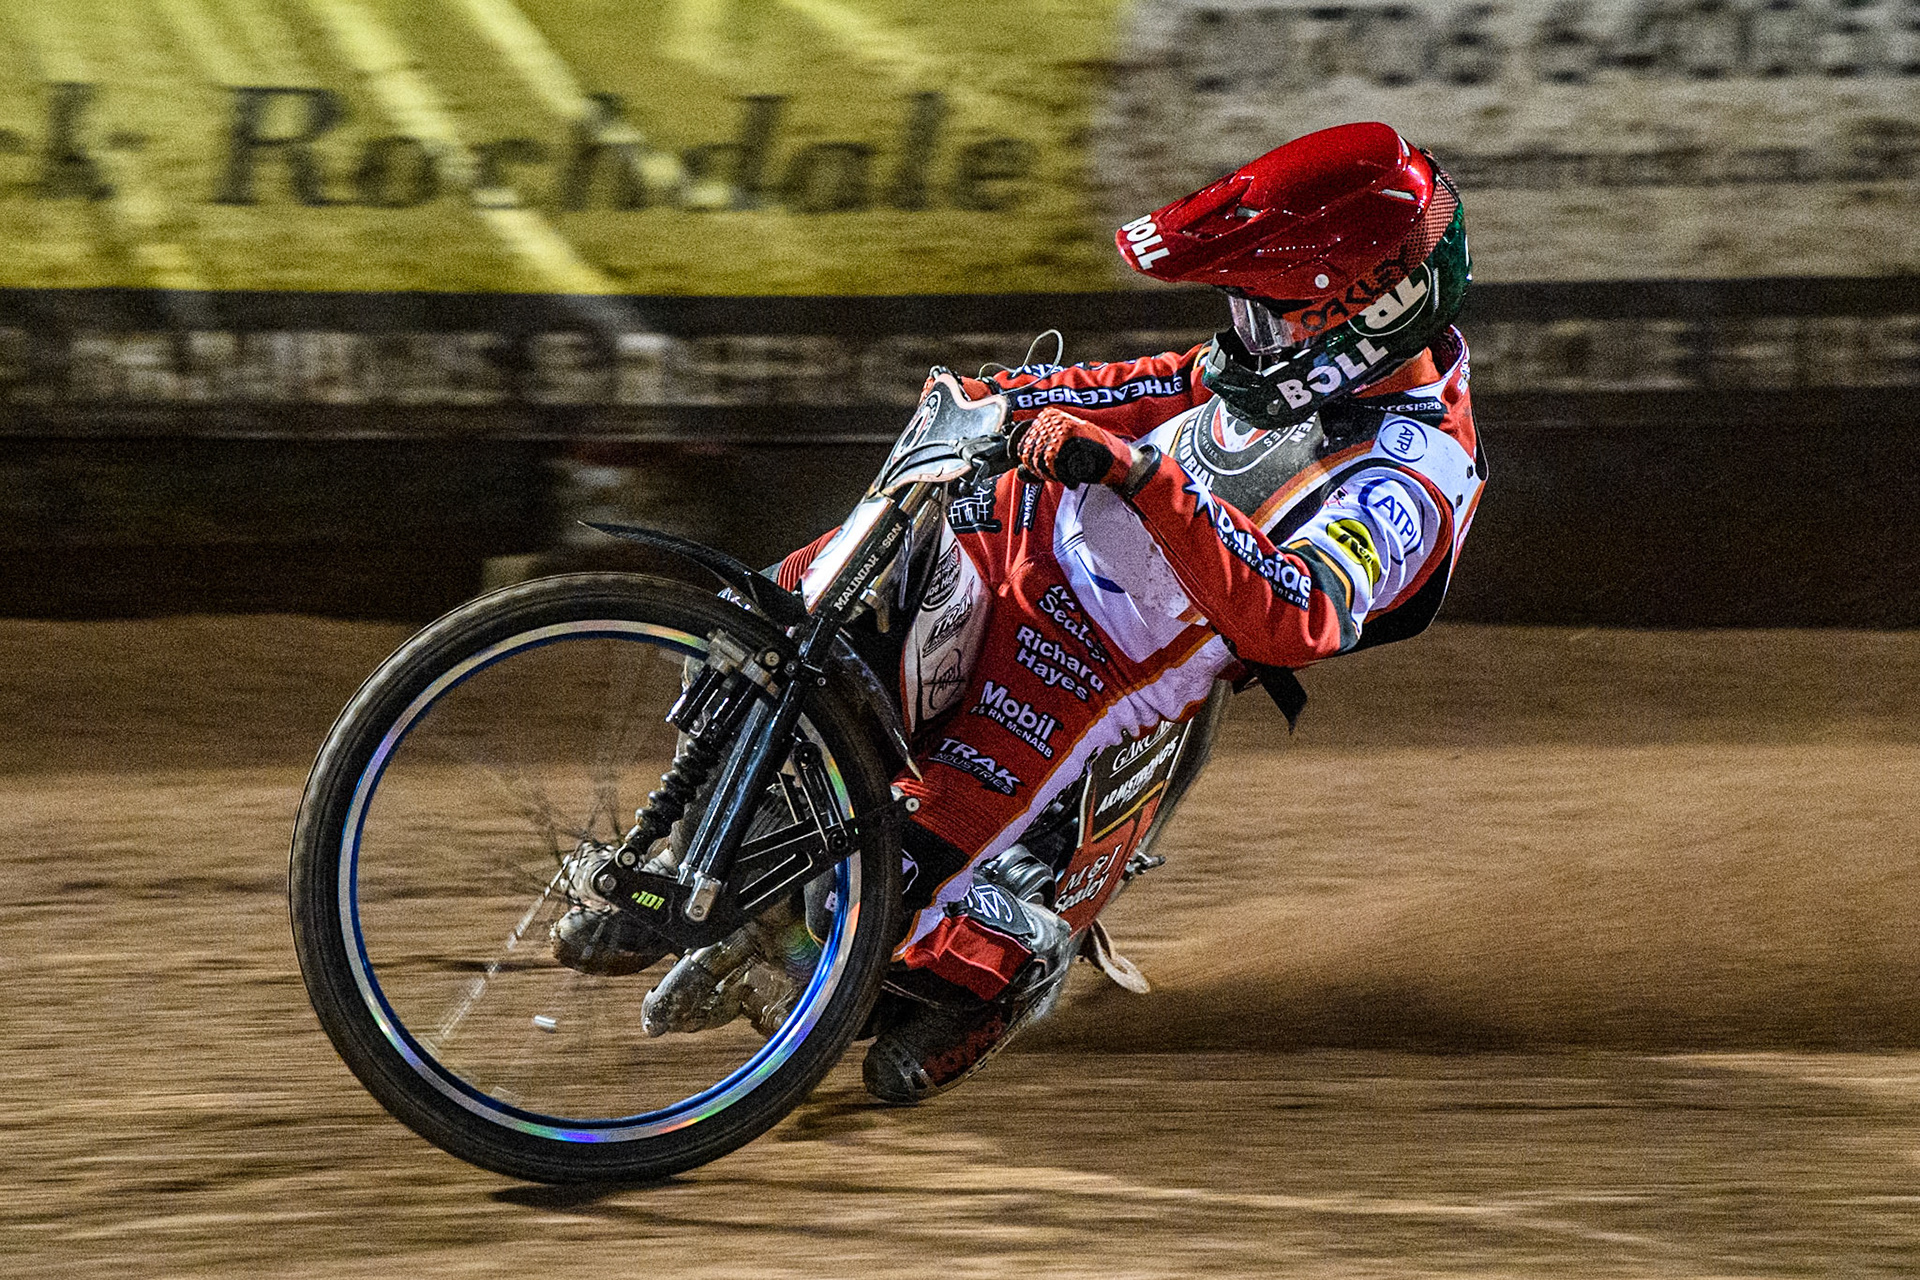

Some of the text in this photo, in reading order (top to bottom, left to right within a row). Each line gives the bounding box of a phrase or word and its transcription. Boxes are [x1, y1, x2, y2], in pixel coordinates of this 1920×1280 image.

[206, 84, 1038, 210] Rochdale
[1121, 214, 1170, 270] BOLL
[1301, 259, 1401, 332] OAKLEY
[1276, 338, 1389, 410] BOLL
[1394, 425, 1415, 455] ATPI
[1373, 495, 1418, 548] ATPI
[1017, 648, 1088, 700] Hayes
[980, 680, 1056, 740] Mobil
[940, 738, 1021, 788] TRAK
[1006, 721, 1053, 758] McNABB
[1062, 864, 1089, 894] M
